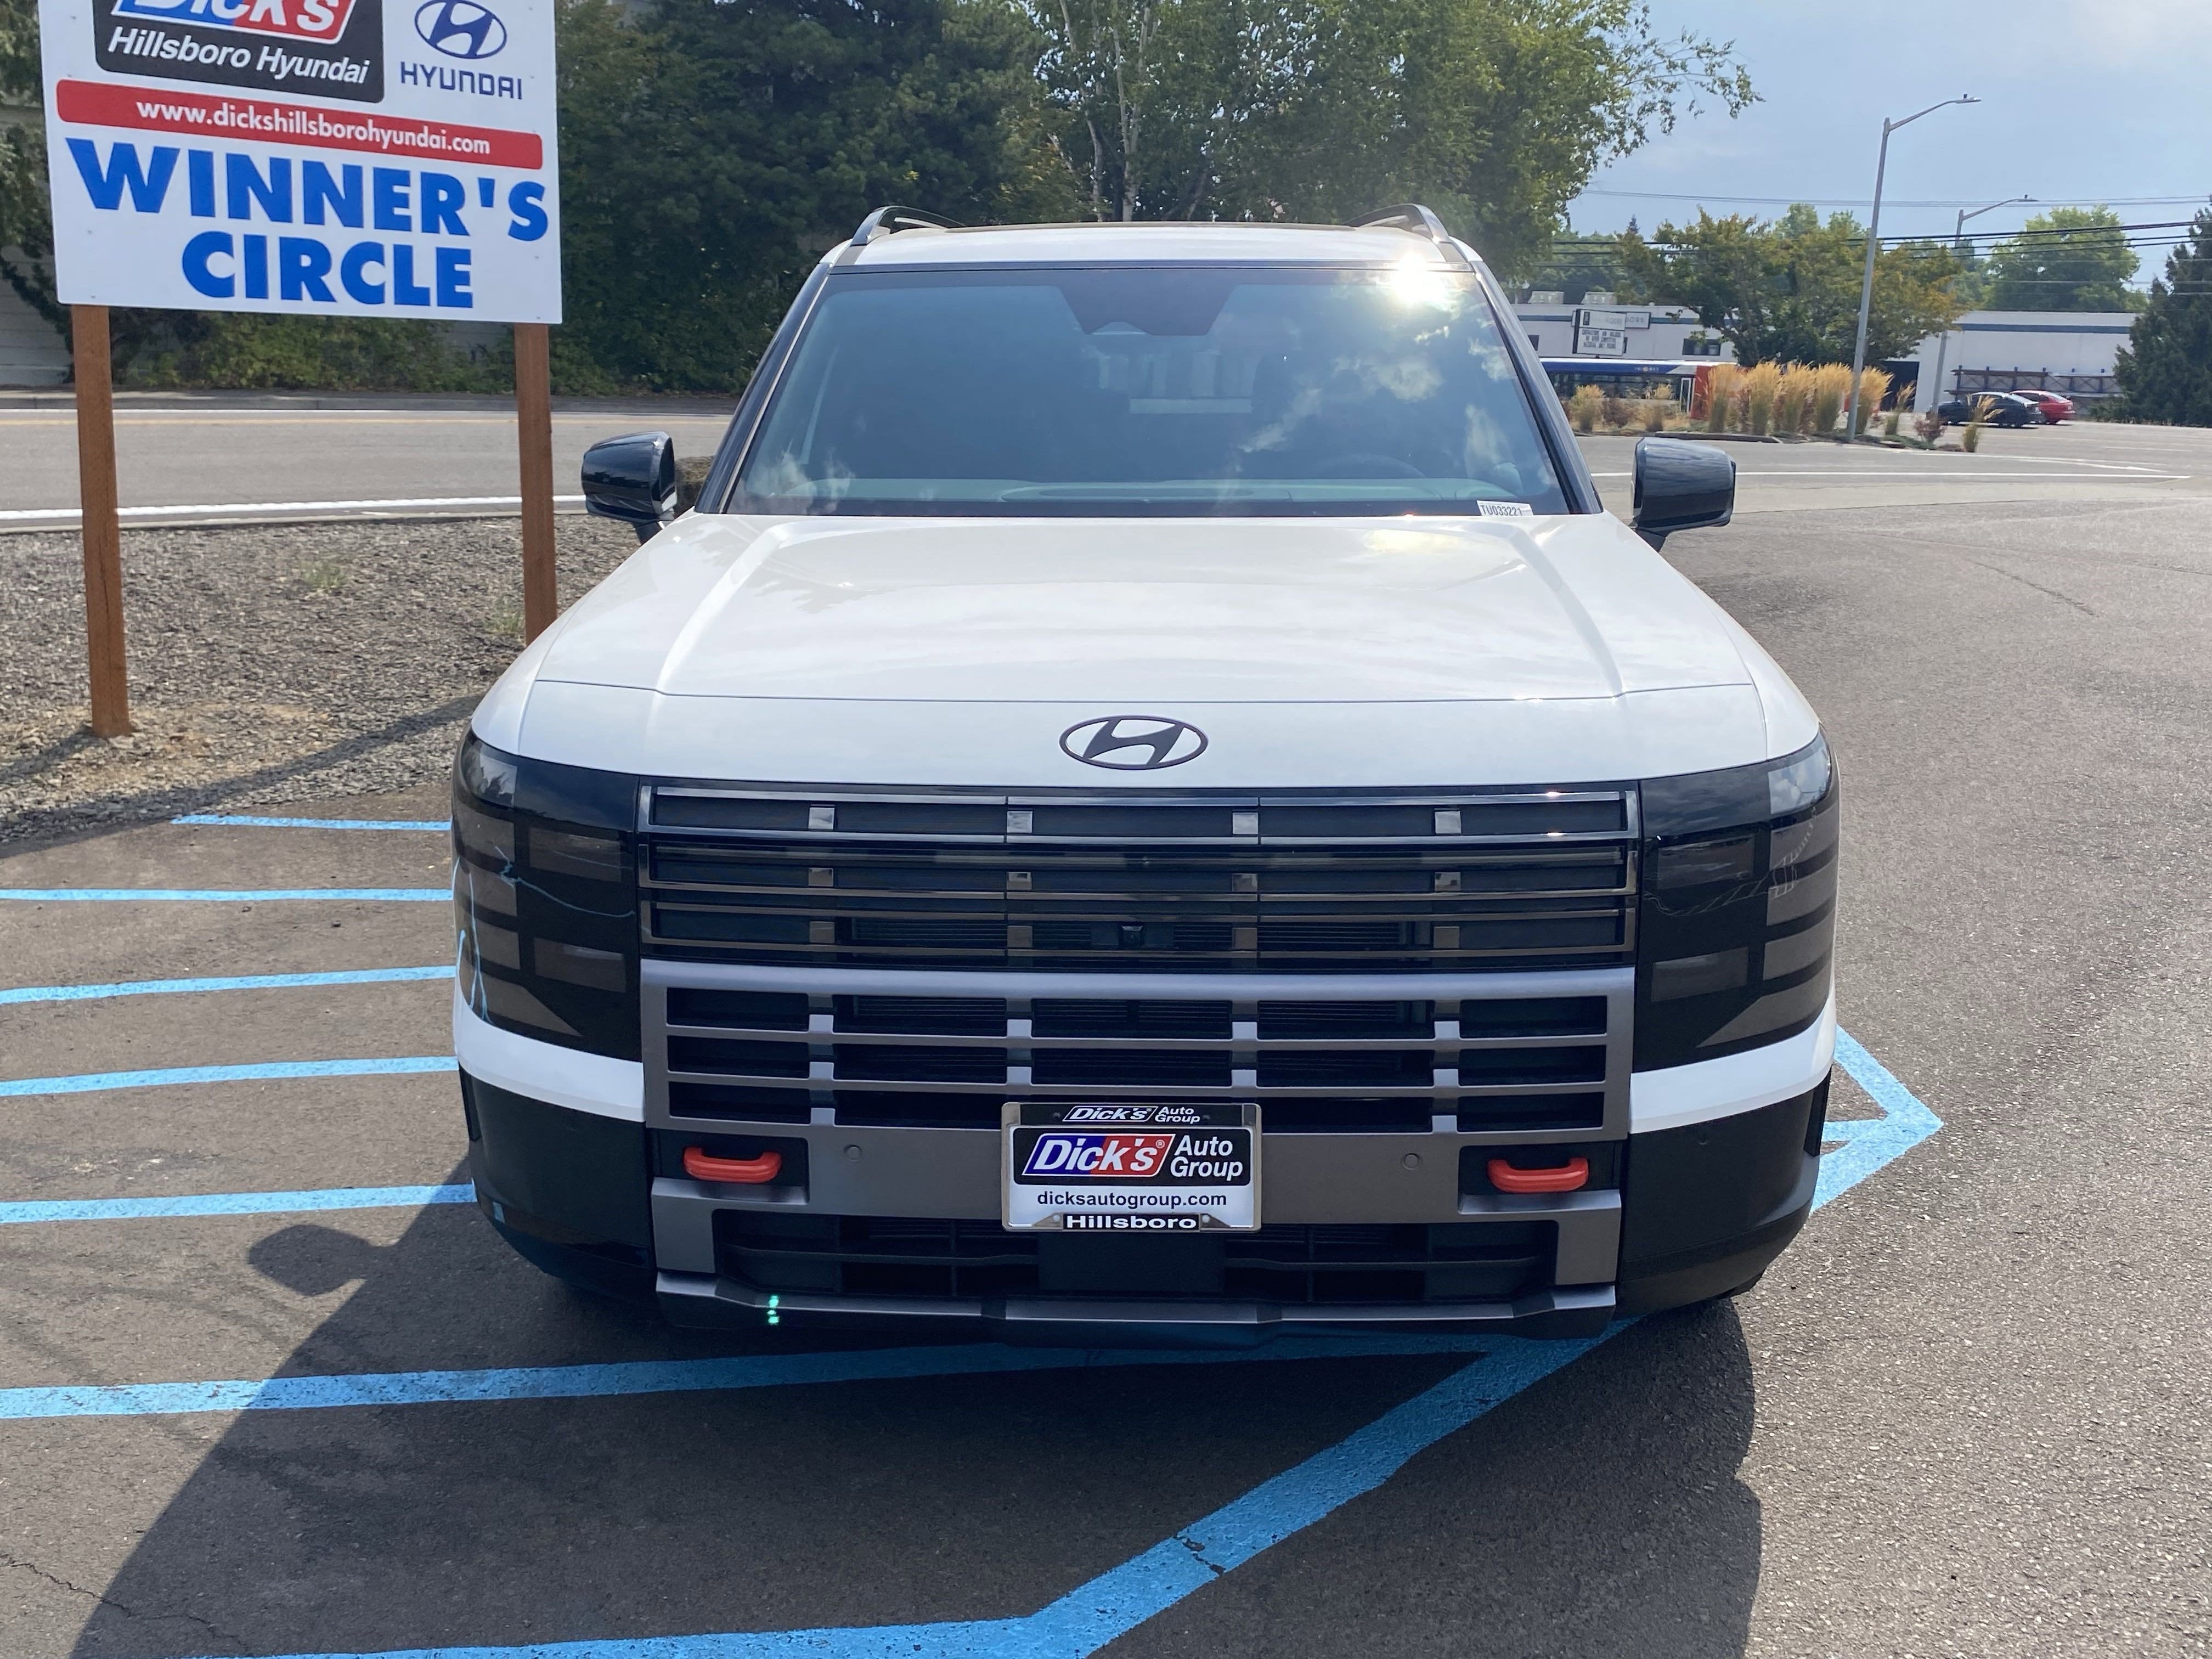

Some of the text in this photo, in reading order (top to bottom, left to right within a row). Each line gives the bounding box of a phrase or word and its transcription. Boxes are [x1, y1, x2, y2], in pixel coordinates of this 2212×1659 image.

[133, 0, 340, 31] cks
[108, 26, 370, 84] Hillsboro Hyundai
[400, 61, 522, 100] HYUNDAI
[136, 100, 490, 156] www.dickshillsborohyundai.com
[66, 138, 549, 241] WINNER'S
[182, 231, 473, 308] CIRCLE
[1069, 1107, 1149, 1120] Dick's
[1155, 1114, 1201, 1124] Group
[1158, 1106, 1194, 1115] Auto
[1033, 1138, 1158, 1171] Dick's
[1174, 1135, 1233, 1156] Auto
[1170, 1157, 1243, 1182] Group
[1037, 1191, 1227, 1209] dicksautogroup.com
[1066, 1215, 1197, 1229] Hillsboro
